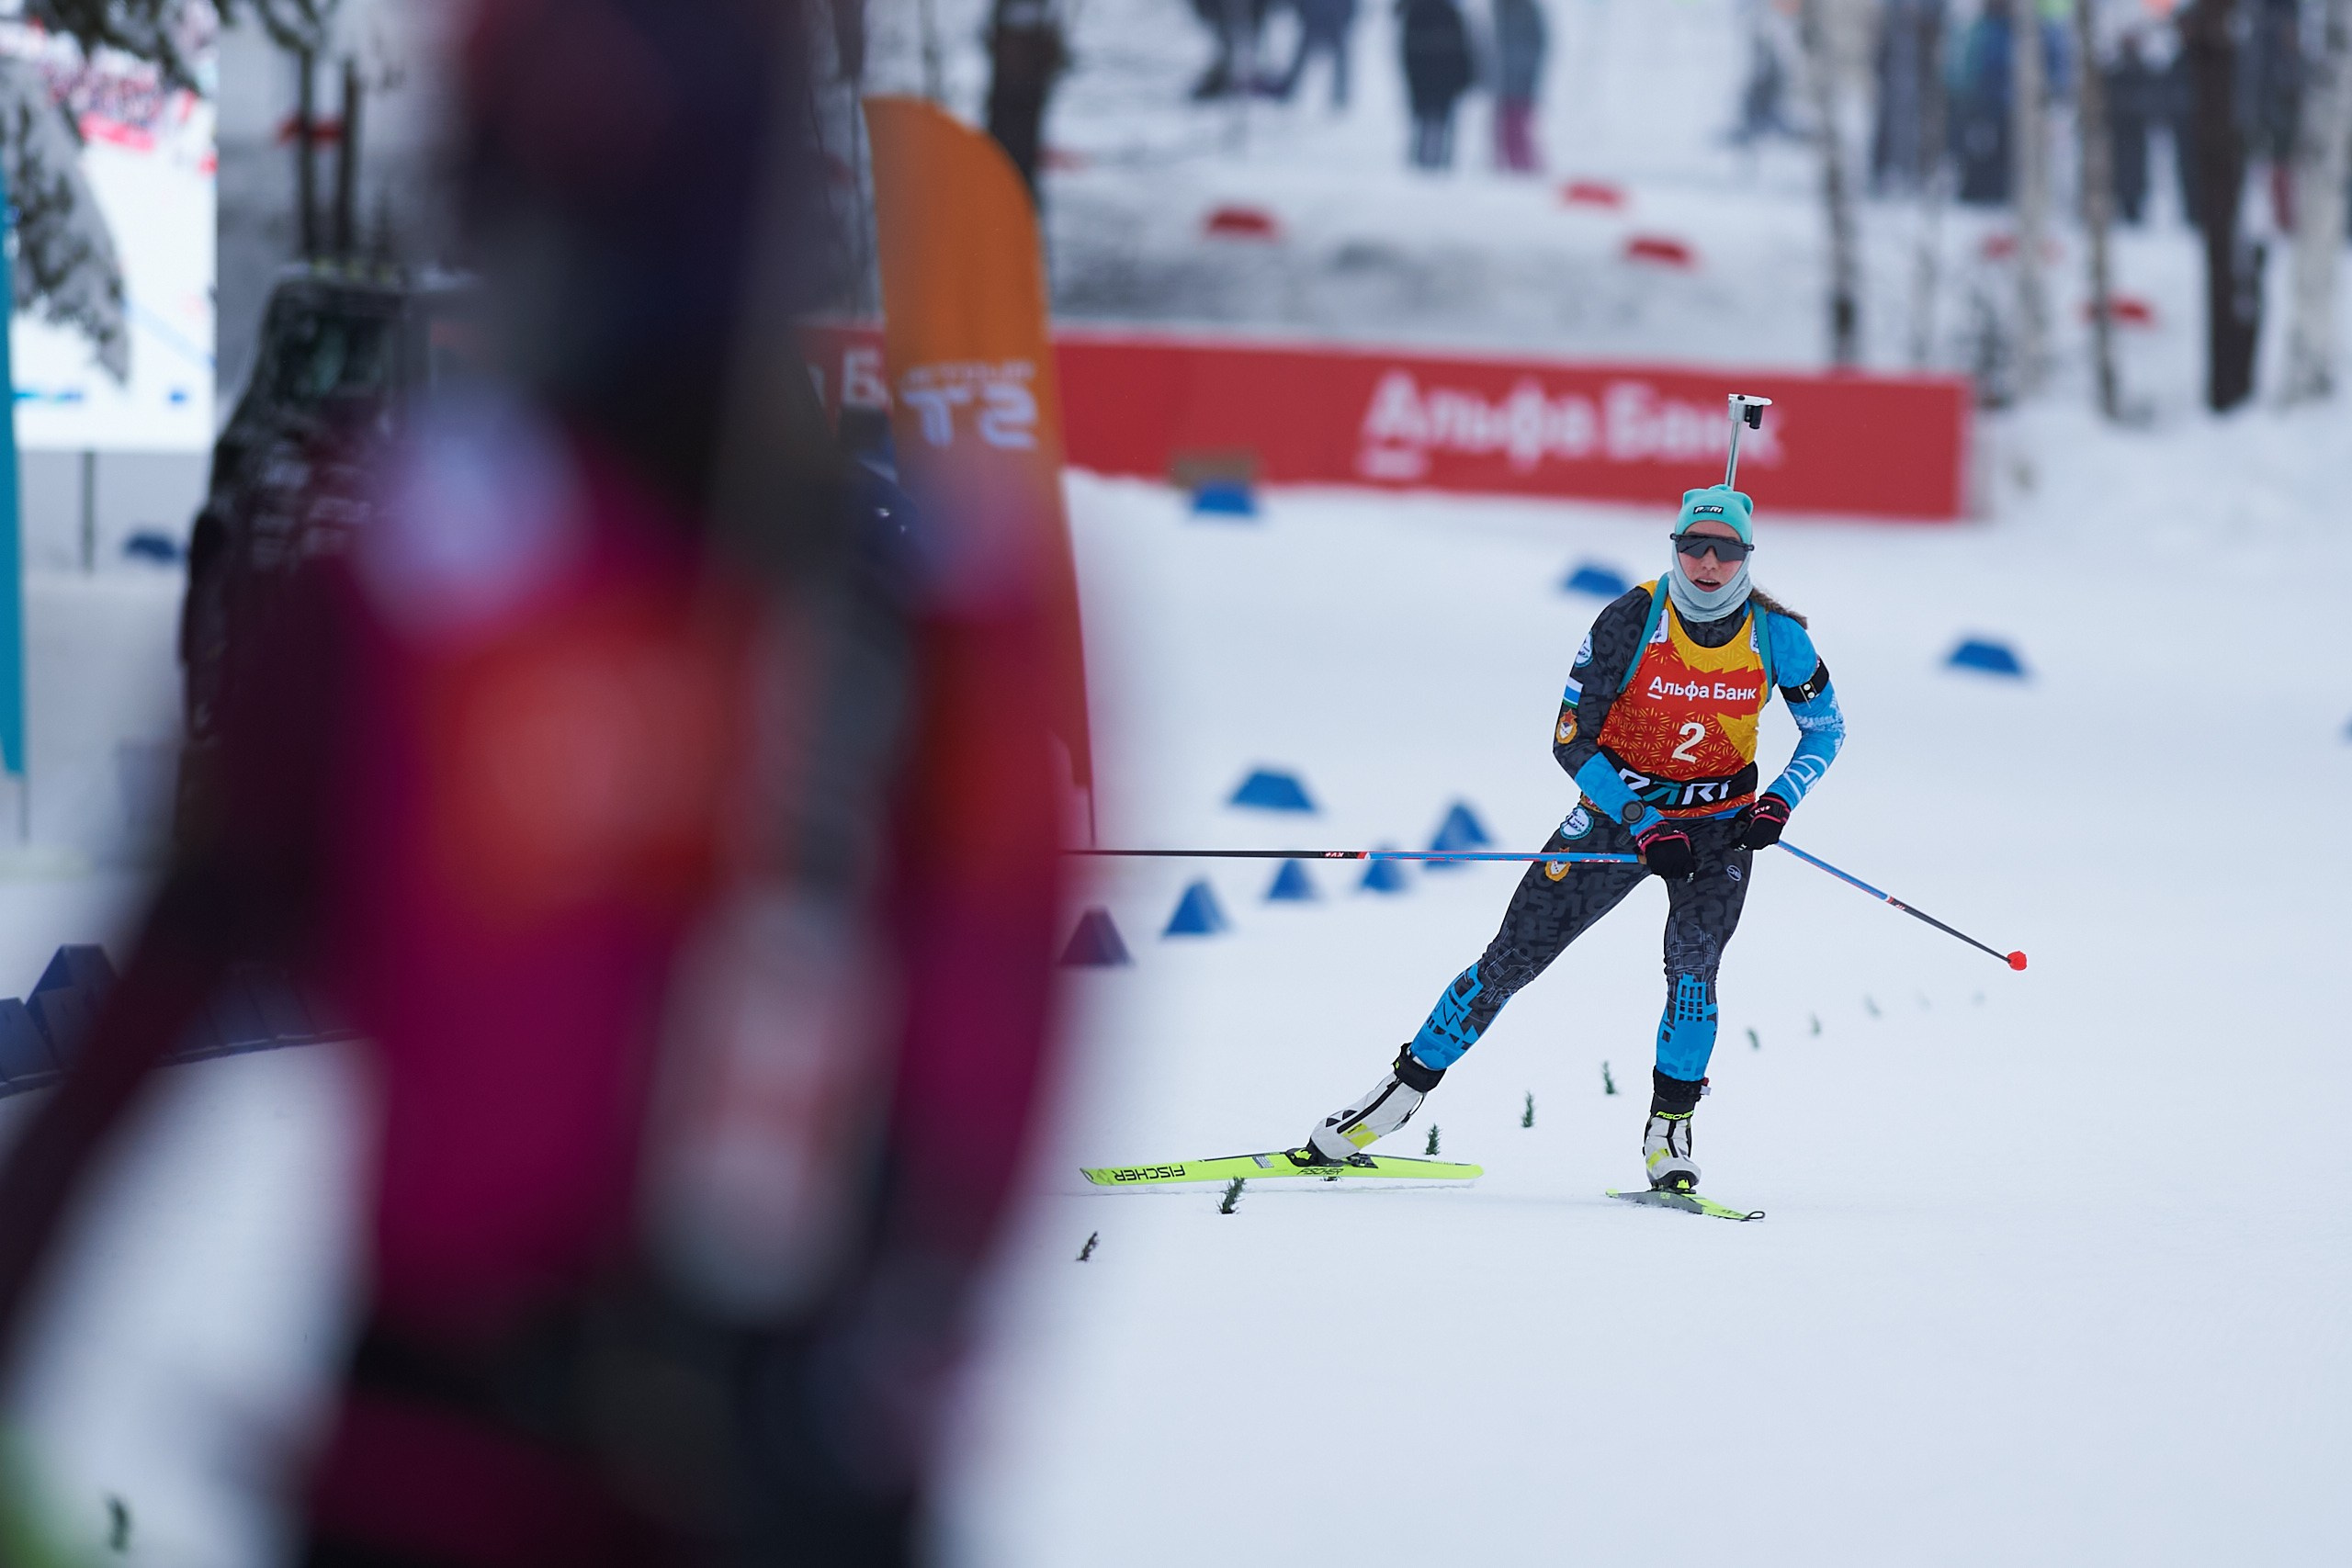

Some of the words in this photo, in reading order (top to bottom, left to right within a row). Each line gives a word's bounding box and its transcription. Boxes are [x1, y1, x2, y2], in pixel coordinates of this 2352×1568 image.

[1363, 371, 1598, 473] Альфа
[1648, 675, 1710, 701] Альфа
[1713, 682, 1758, 700] Банк
[1671, 722, 1706, 763] 2
[1111, 1164, 1186, 1181] FISCHER
